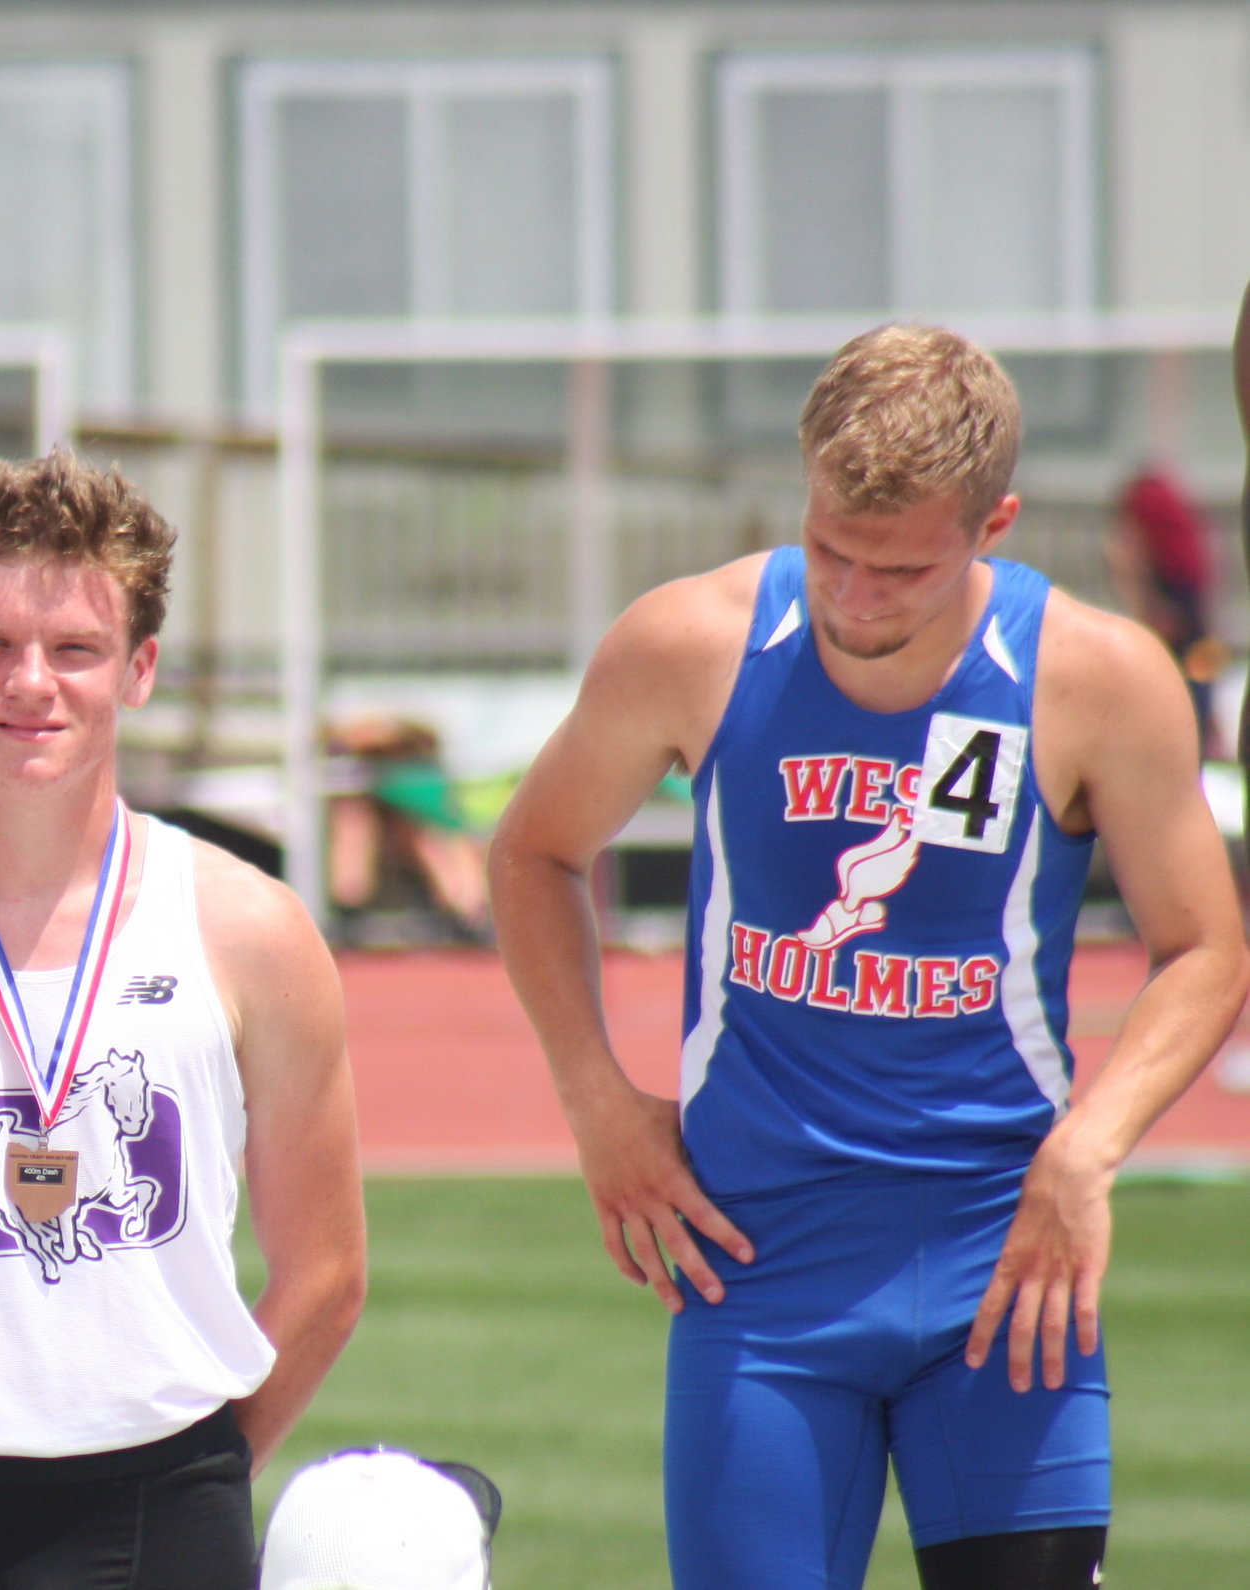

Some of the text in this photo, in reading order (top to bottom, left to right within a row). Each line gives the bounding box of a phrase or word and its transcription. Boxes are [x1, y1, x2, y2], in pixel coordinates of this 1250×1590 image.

[779, 755, 921, 830] WES
[927, 729, 1002, 840] 4
[729, 921, 1000, 1018] HOLMES
[42, 1168, 59, 1176] Dash
